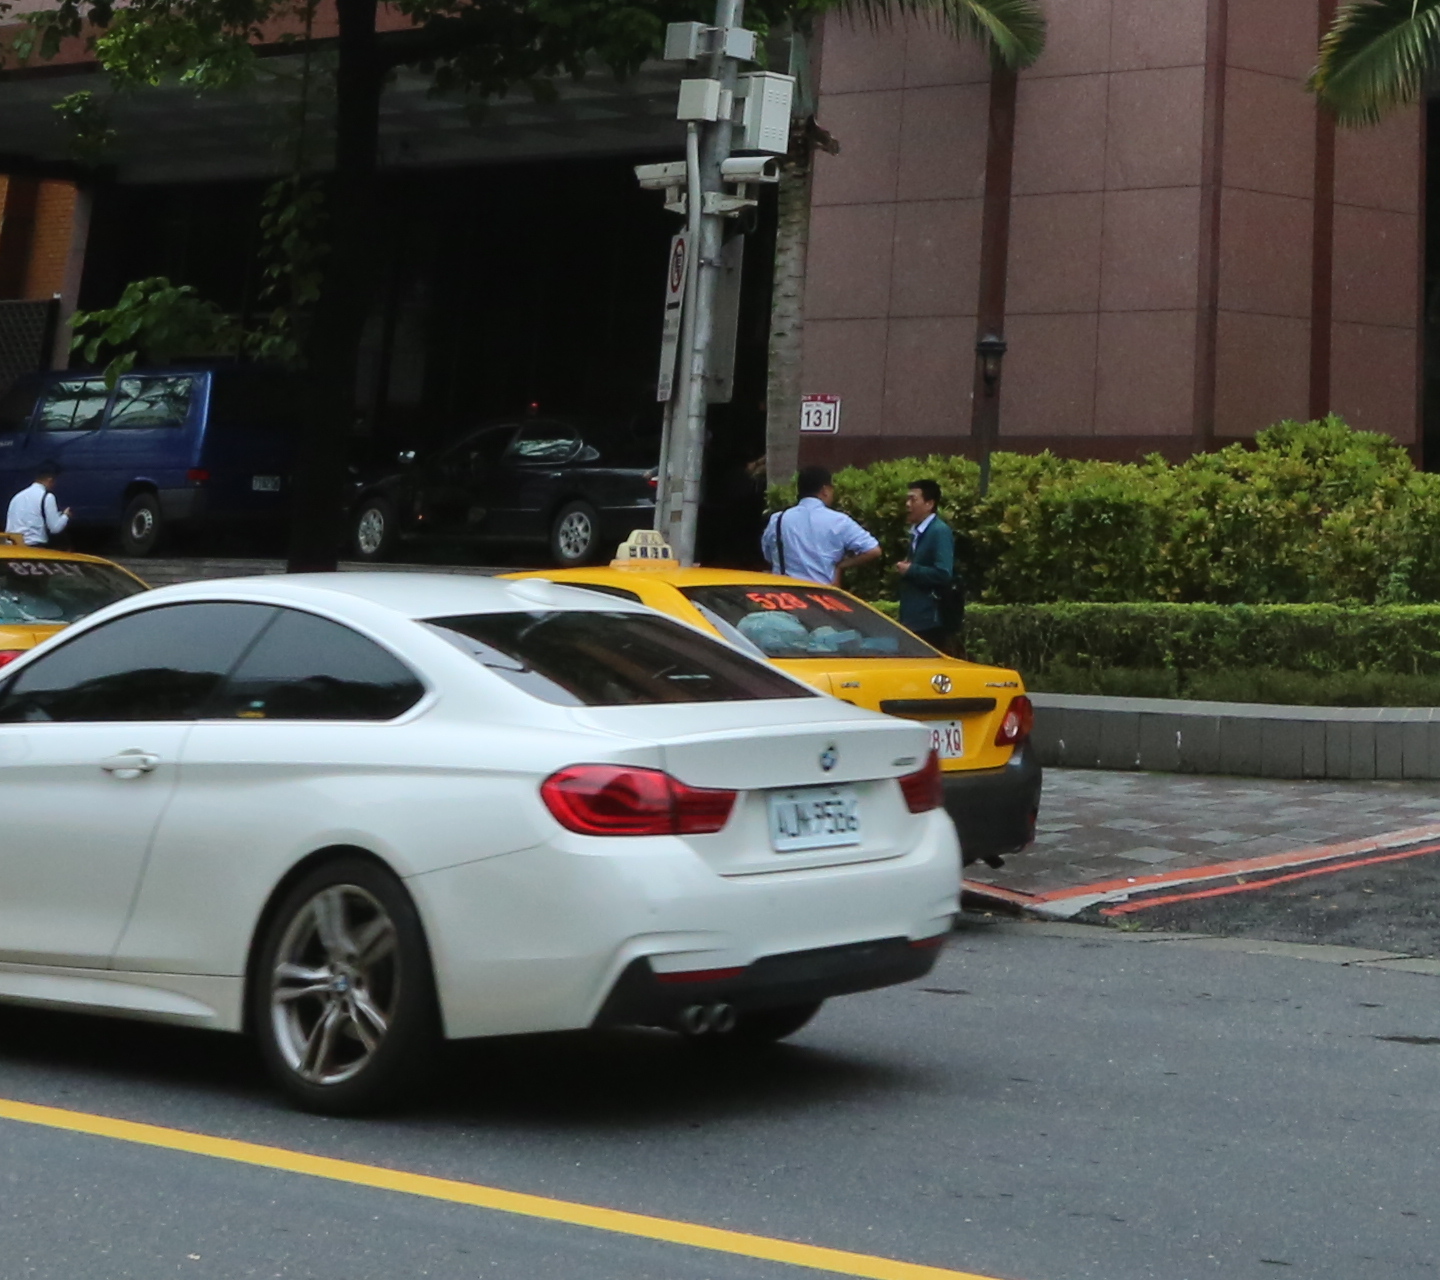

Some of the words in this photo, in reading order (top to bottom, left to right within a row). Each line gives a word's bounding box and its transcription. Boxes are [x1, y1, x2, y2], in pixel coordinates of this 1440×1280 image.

[805, 410, 831, 427] 131
[9, 561, 84, 577] 821-LY
[929, 728, 962, 753] 8-XQ
